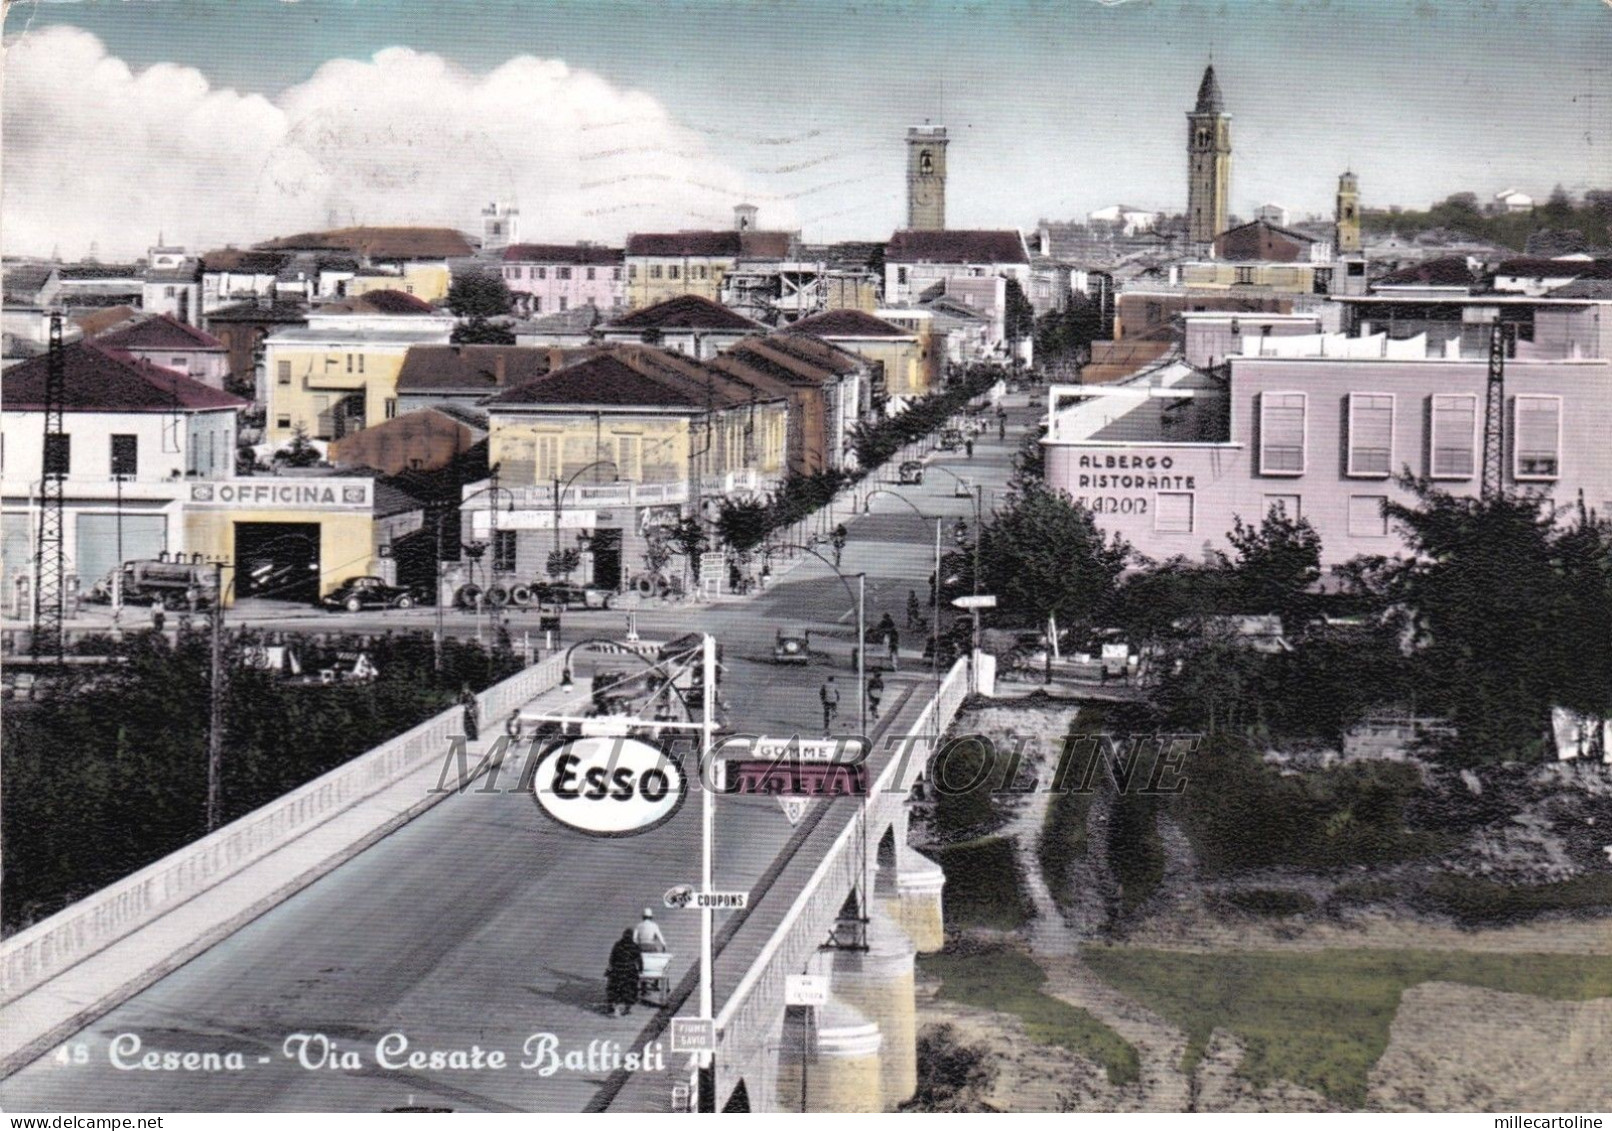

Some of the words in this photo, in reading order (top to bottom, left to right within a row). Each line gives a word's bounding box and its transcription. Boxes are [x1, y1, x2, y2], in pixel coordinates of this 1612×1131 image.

[1079, 455, 1173, 469] ALBERGO
[1079, 474, 1195, 489] RISTORANTE
[219, 485, 335, 503] OFFICINA
[760, 746, 828, 758] GOMME
[552, 754, 670, 802] Esso
[697, 894, 744, 907] COUPONS
